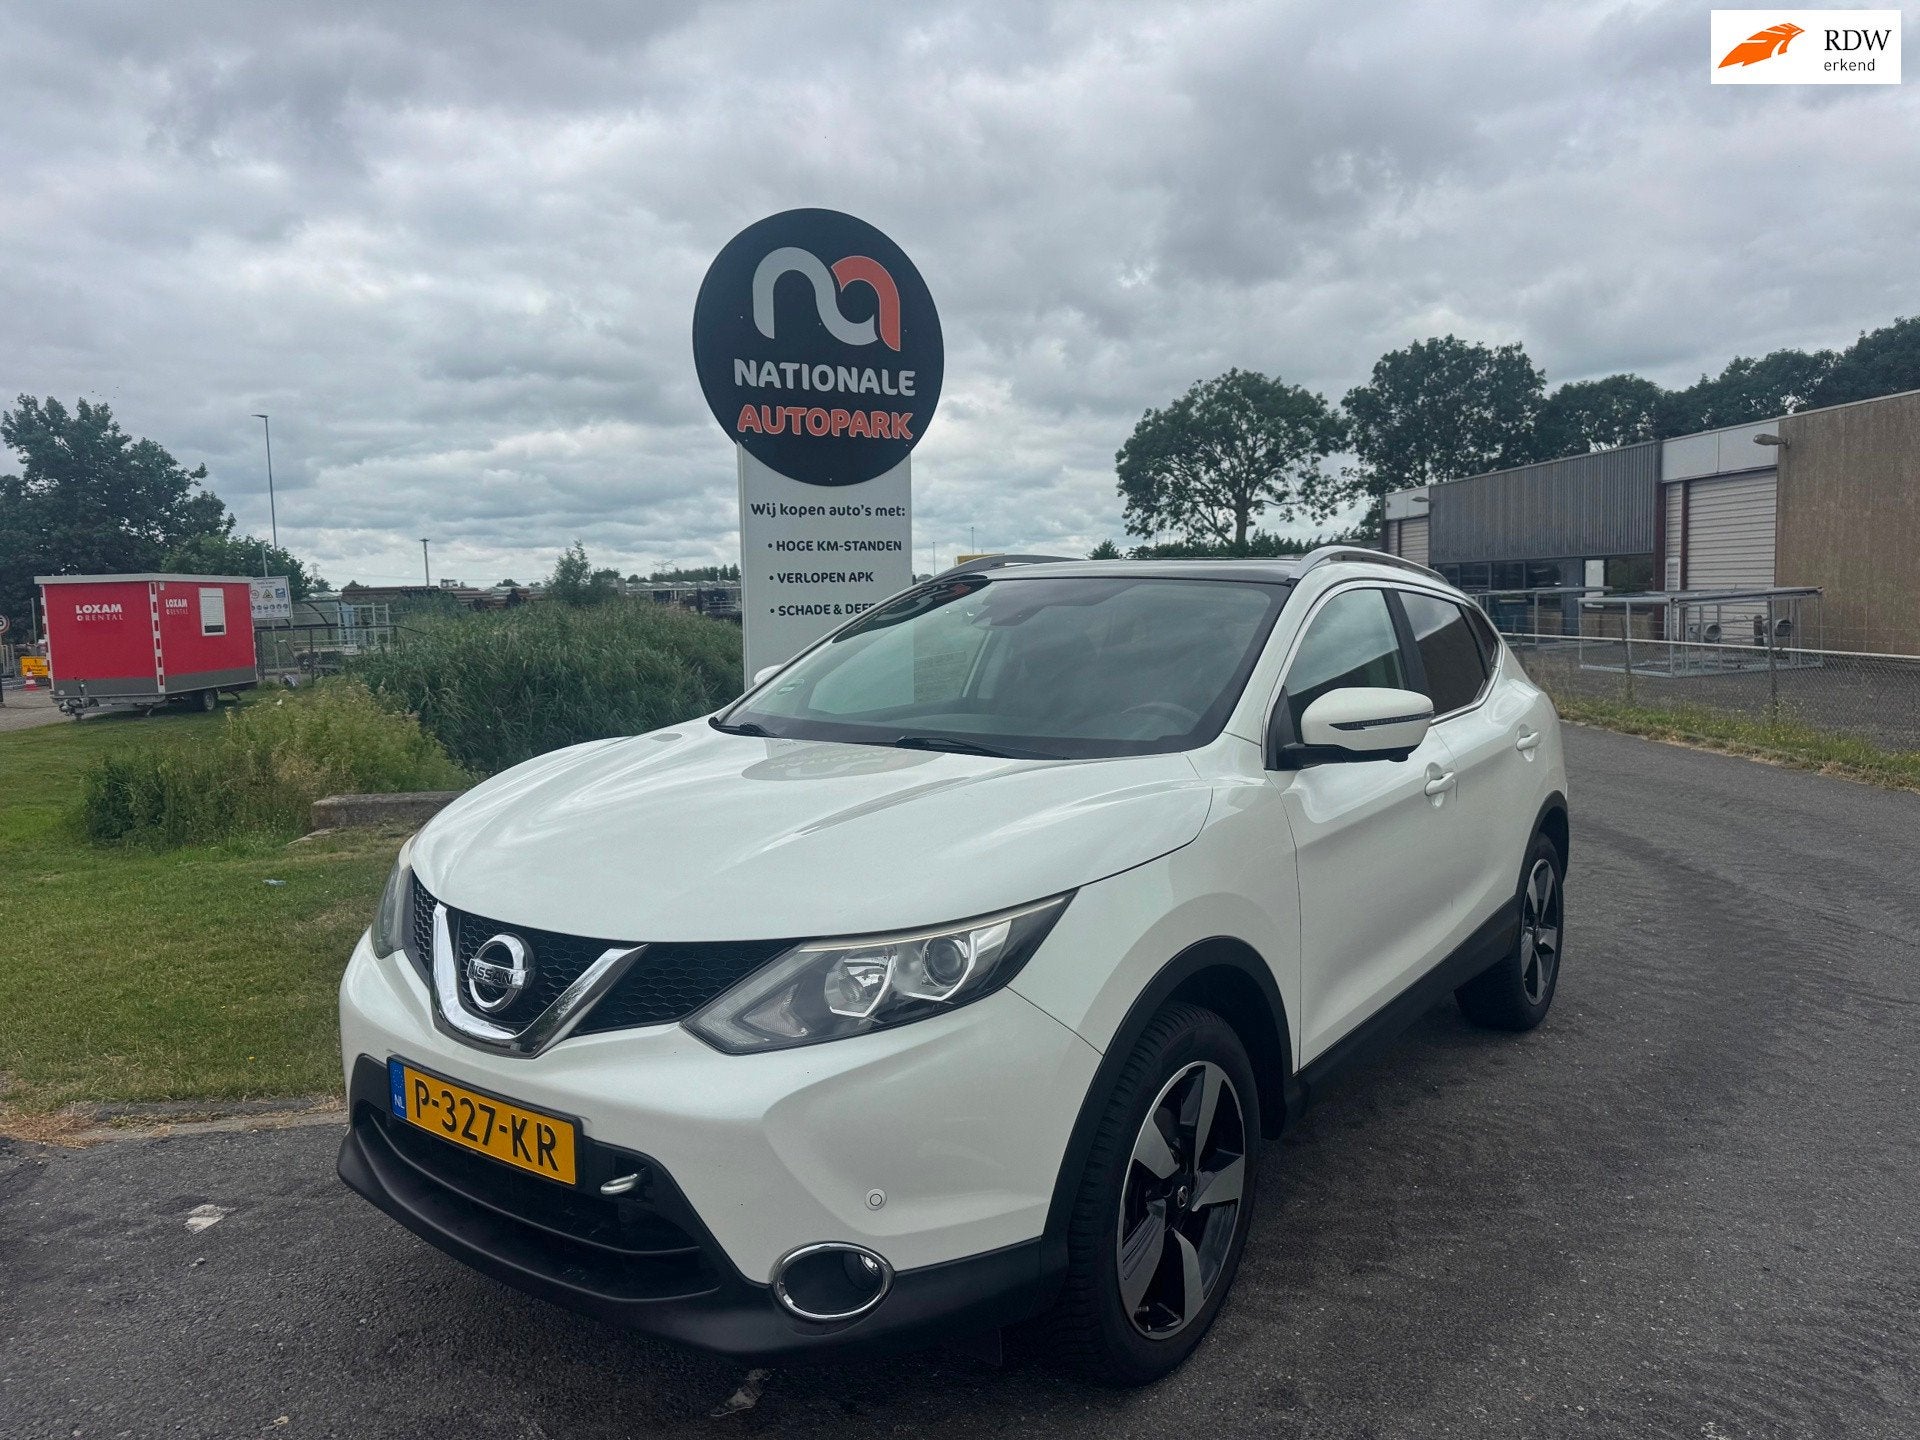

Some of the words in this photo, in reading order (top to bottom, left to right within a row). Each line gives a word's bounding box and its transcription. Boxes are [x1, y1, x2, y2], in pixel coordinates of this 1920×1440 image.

[733, 358, 916, 397] NATIONALE
[736, 404, 914, 440] AUTOPARK
[750, 502, 776, 518] Wij
[780, 503, 826, 518] kopen
[829, 504, 872, 517] auto's
[875, 504, 906, 517] met:
[776, 540, 814, 552] HOGE
[817, 540, 902, 551] KM-STANDEN
[777, 572, 846, 584] VERLOPEN
[848, 571, 874, 583] APK
[75, 603, 123, 614] LOXAM
[165, 598, 188, 608] LOXAM
[778, 604, 831, 616] SCHADE
[833, 604, 843, 615] &
[845, 603, 877, 615] DEF
[85, 613, 124, 621] RENTAL
[470, 959, 514, 985] NISSAN
[394, 1093, 405, 1109] NL
[414, 1078, 559, 1172] P-327-KR
